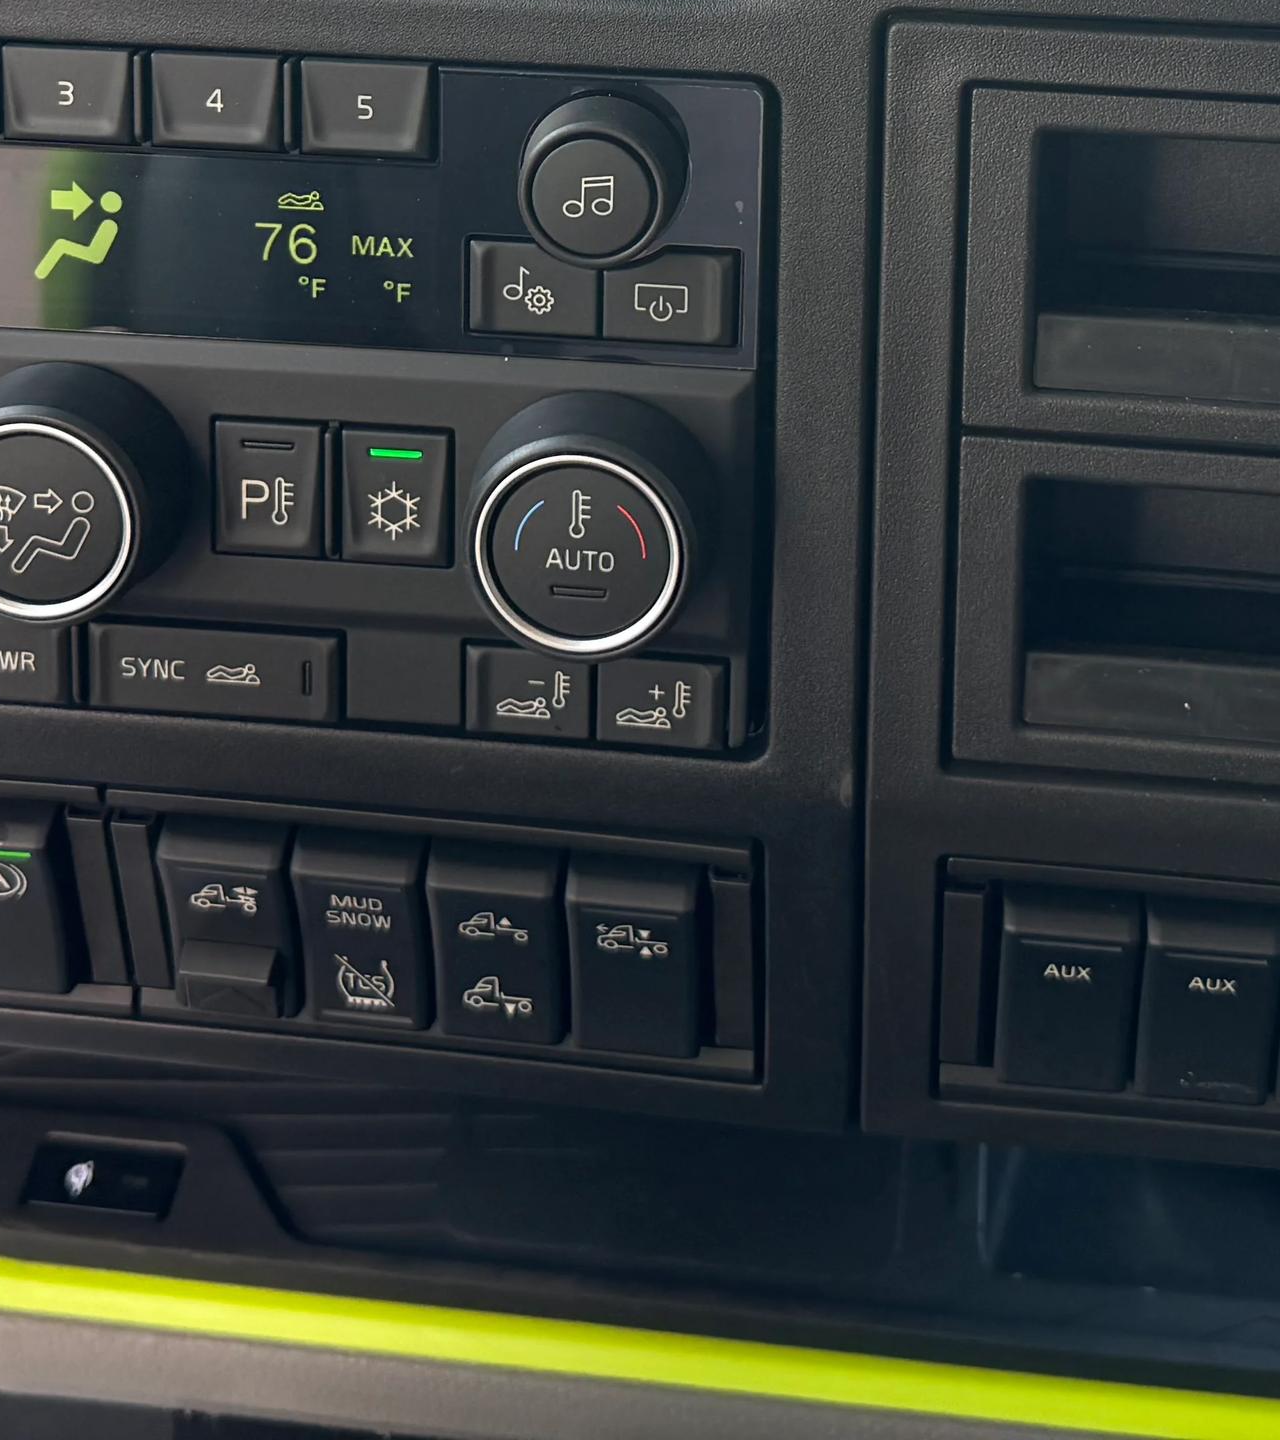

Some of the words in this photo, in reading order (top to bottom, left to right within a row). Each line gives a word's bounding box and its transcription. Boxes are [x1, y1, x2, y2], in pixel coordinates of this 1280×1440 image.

[58, 80, 74, 106] 3
[205, 88, 224, 113] 4
[357, 95, 373, 120] 5
[254, 222, 317, 265] 76
[352, 235, 414, 258] MAX
[241, 479, 270, 520] P
[545, 547, 615, 573] AUTO
[121, 656, 185, 680] SYNC
[329, 893, 384, 912] MUD
[325, 909, 392, 930] SNOW
[1043, 963, 1091, 981] AUX
[1188, 976, 1236, 993] AUX
